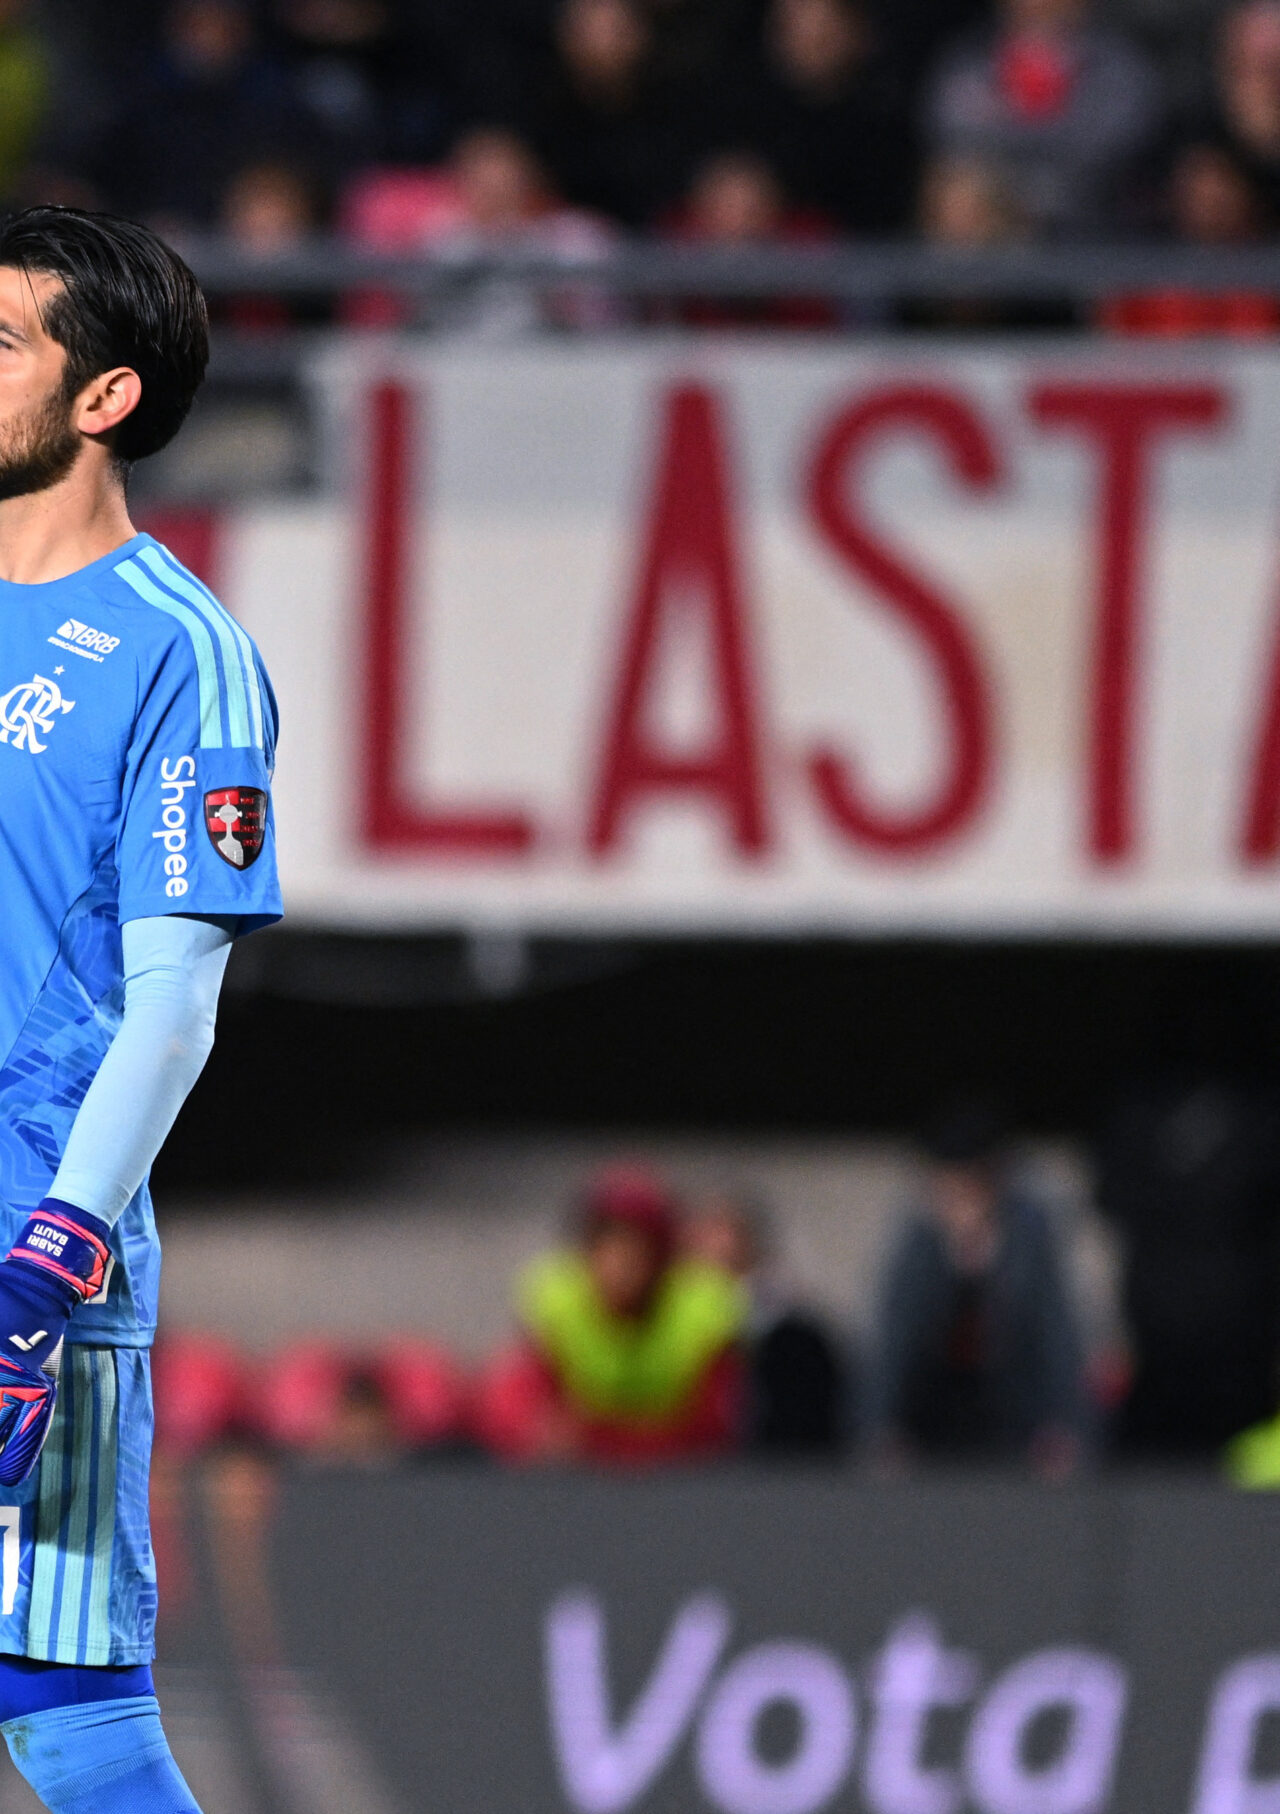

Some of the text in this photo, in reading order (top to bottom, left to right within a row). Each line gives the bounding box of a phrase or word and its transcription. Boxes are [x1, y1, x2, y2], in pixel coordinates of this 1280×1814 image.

[75, 627, 121, 655] BRB
[152, 755, 197, 897] Shopee
[26, 1233, 64, 1257] SABRI
[32, 1223, 69, 1246] BAUTI
[543, 1590, 1130, 1814] Vota
